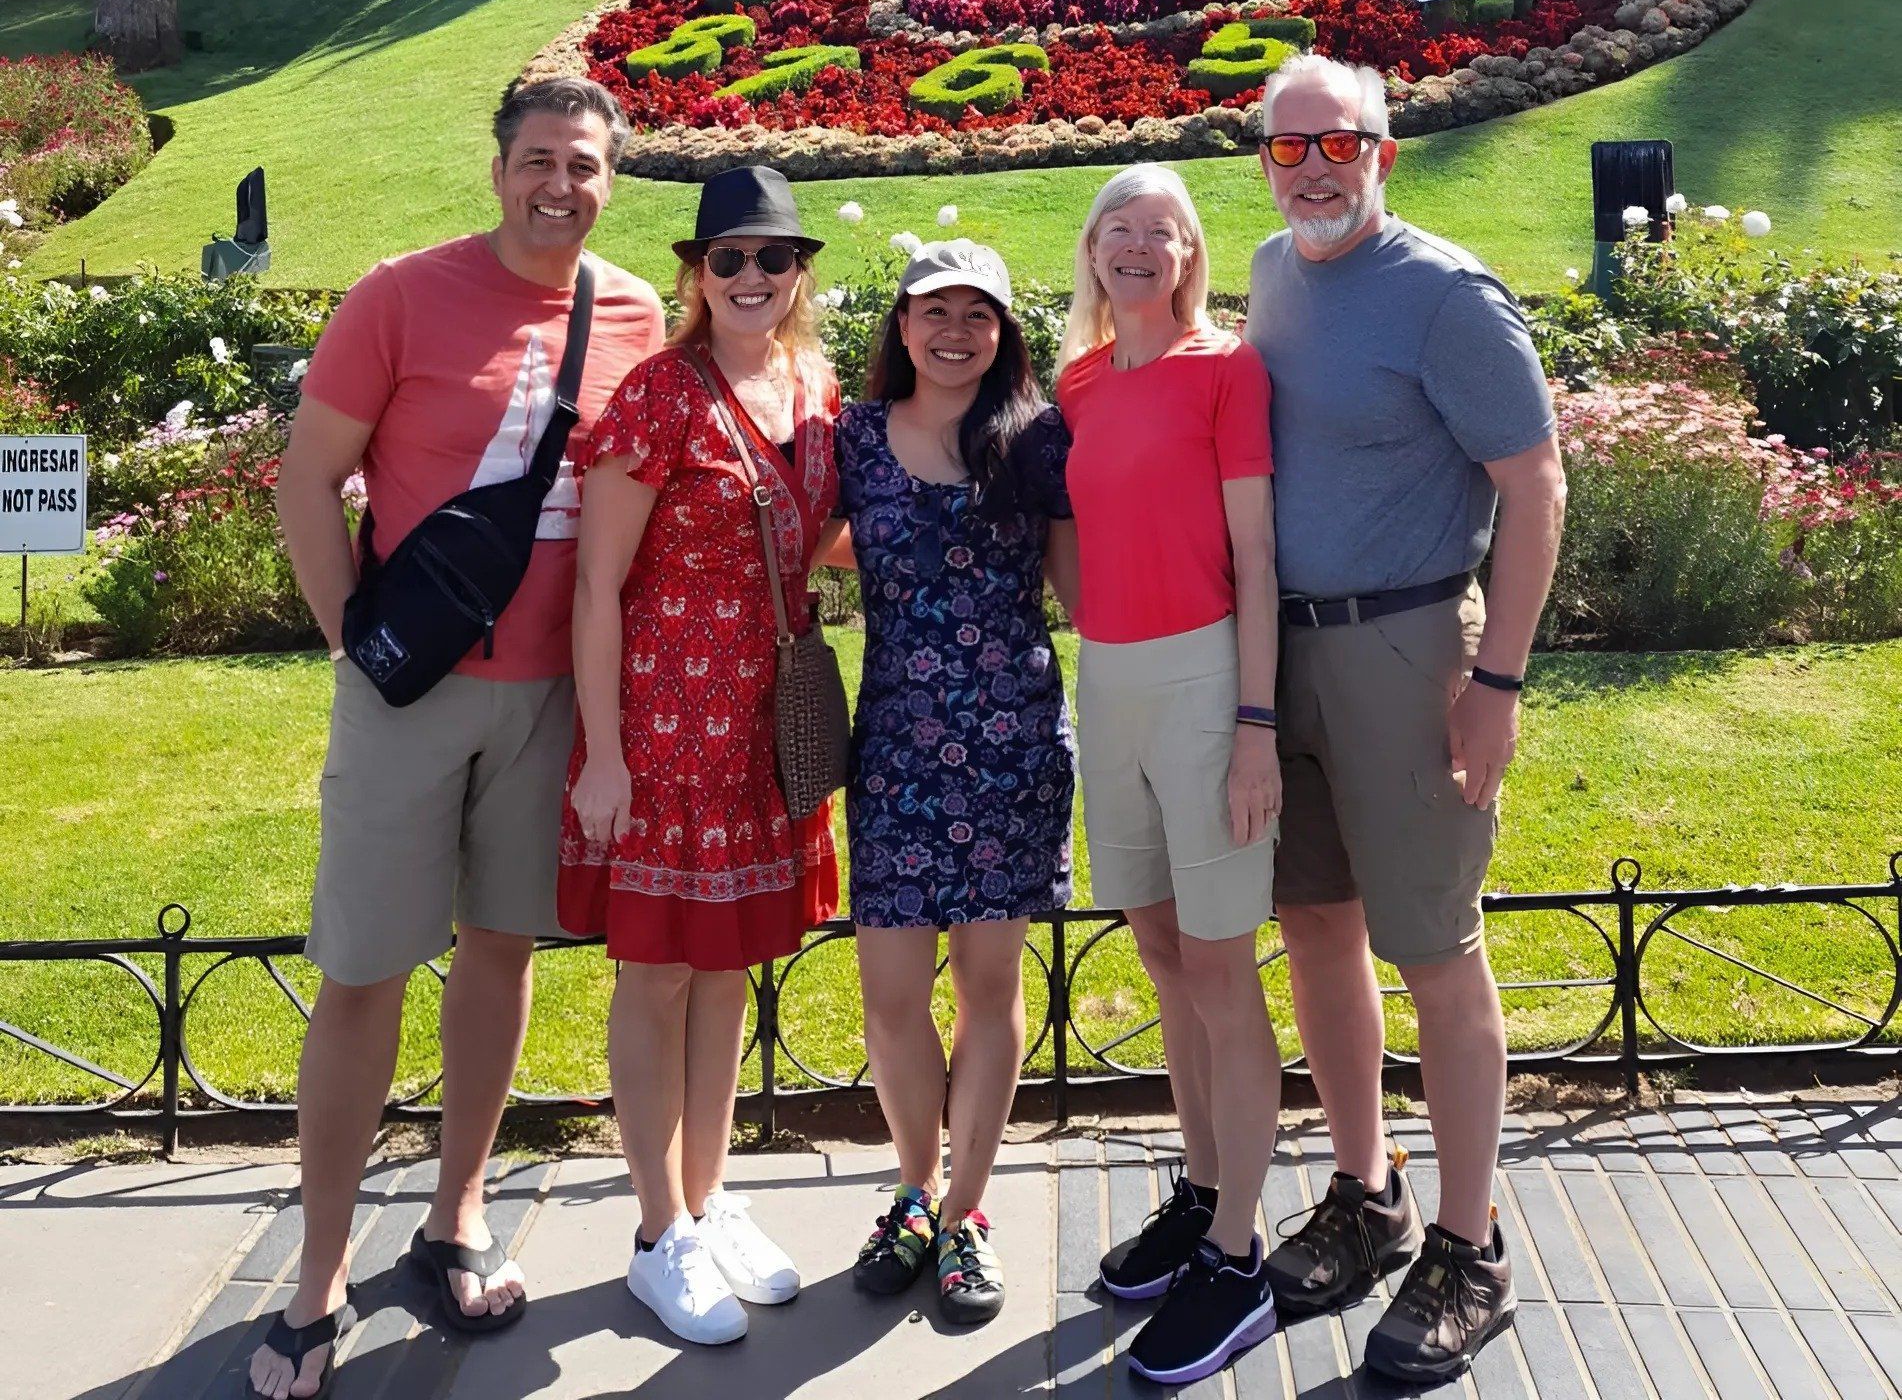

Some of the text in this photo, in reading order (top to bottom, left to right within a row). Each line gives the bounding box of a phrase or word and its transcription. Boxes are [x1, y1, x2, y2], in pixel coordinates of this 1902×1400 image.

[626, 13, 757, 79] 8
[713, 45, 861, 100] 7
[1188, 16, 1317, 89] 5
[909, 43, 1050, 116] 6
[2, 449, 78, 472] INGRESAR
[3, 488, 77, 513] NOT PASS
